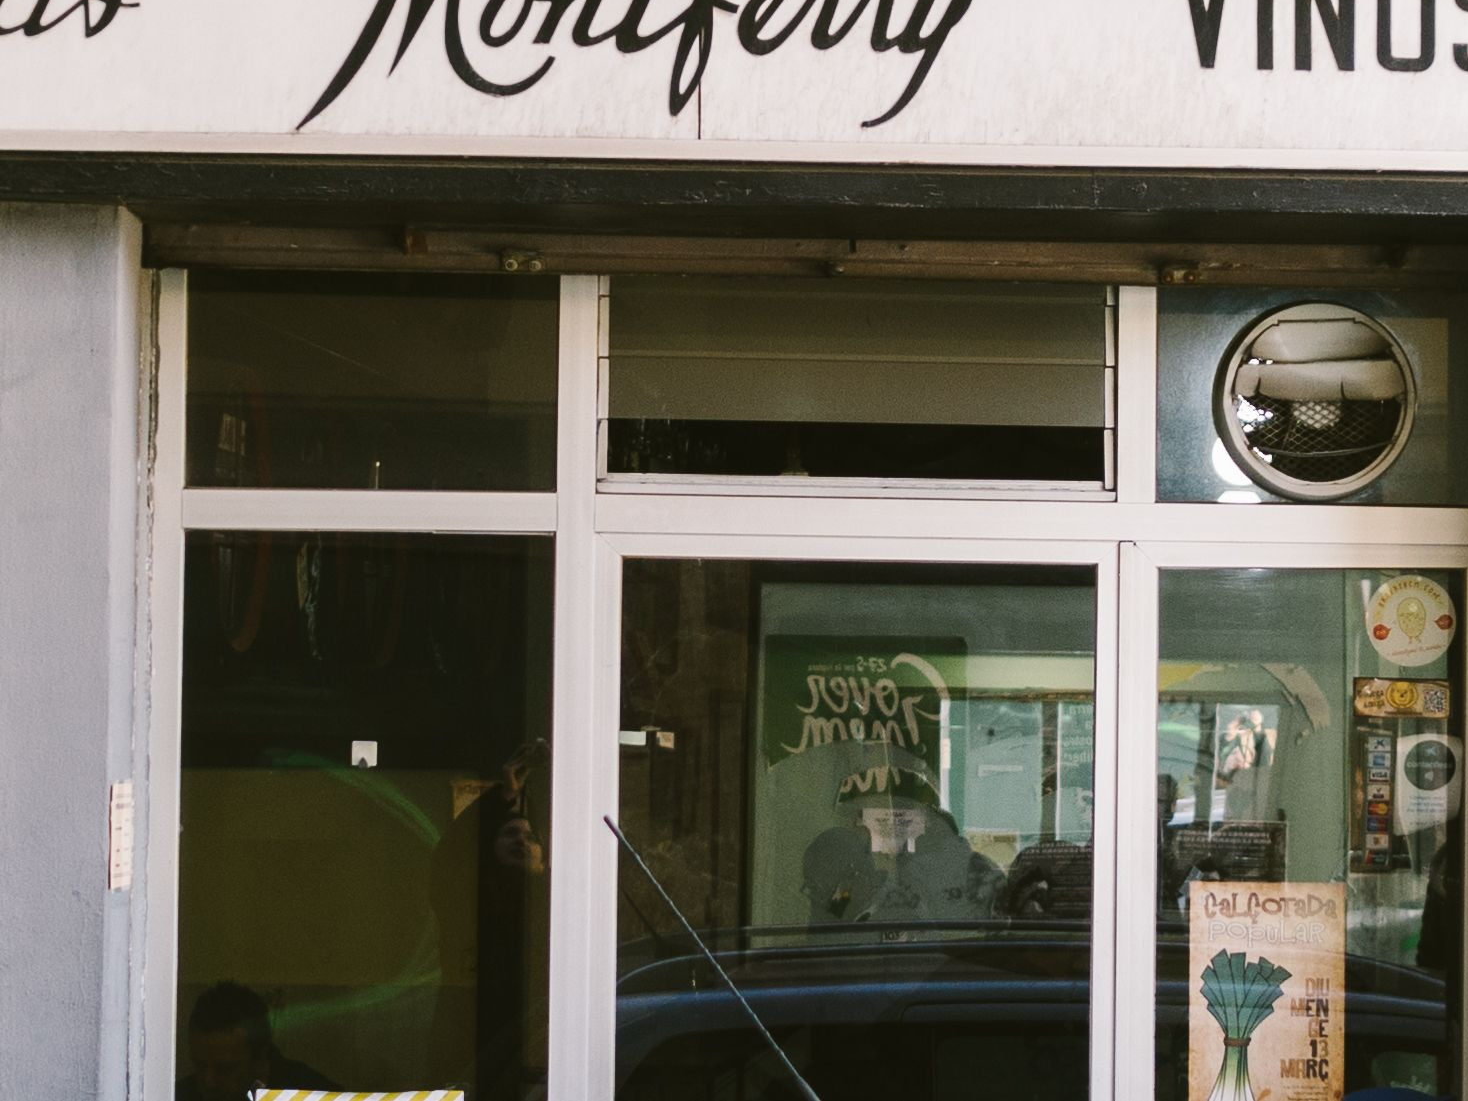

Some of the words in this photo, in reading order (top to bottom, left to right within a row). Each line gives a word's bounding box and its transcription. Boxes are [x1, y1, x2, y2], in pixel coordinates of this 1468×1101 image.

[1371, 771, 1388, 779] VISA
[1305, 977, 1330, 997] DIU
[1290, 998, 1330, 1017] MEN
[1308, 1019, 1329, 1038] GE
[1309, 1039, 1329, 1058] 13
[1280, 1058, 1330, 1082] MARÇ
